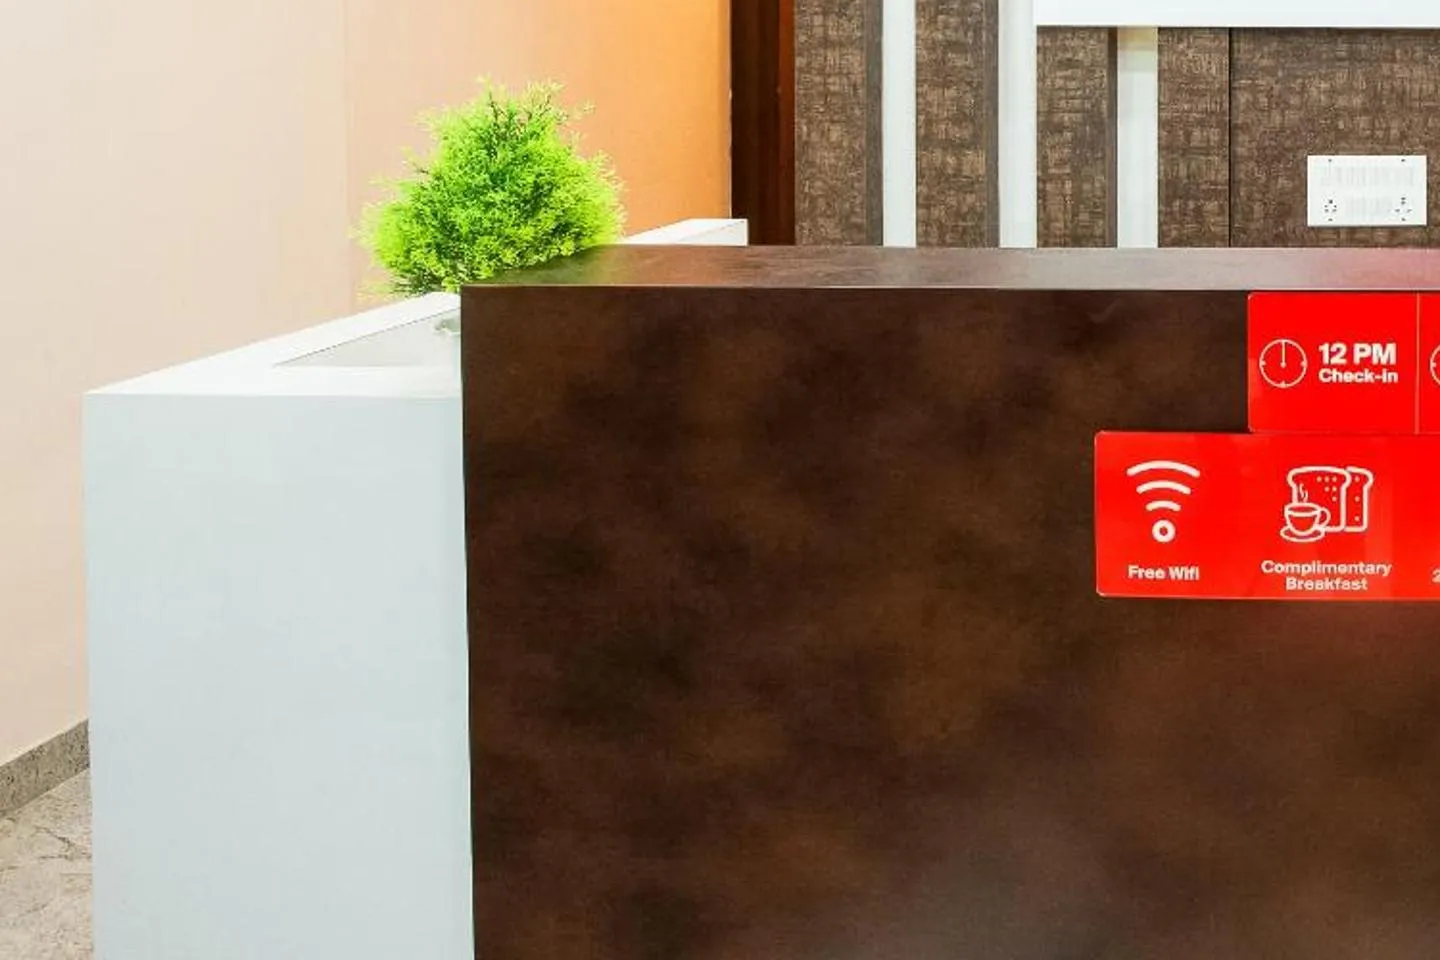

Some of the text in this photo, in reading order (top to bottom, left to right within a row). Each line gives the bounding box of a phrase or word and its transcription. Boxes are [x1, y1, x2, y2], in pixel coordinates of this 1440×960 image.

[1318, 342, 1397, 365] 12 PM
[1318, 368, 1398, 384] Check-in
[1127, 564, 1200, 581] Free Wifi
[1260, 559, 1392, 577] Complimentary
[1285, 576, 1369, 591] Breakfast
